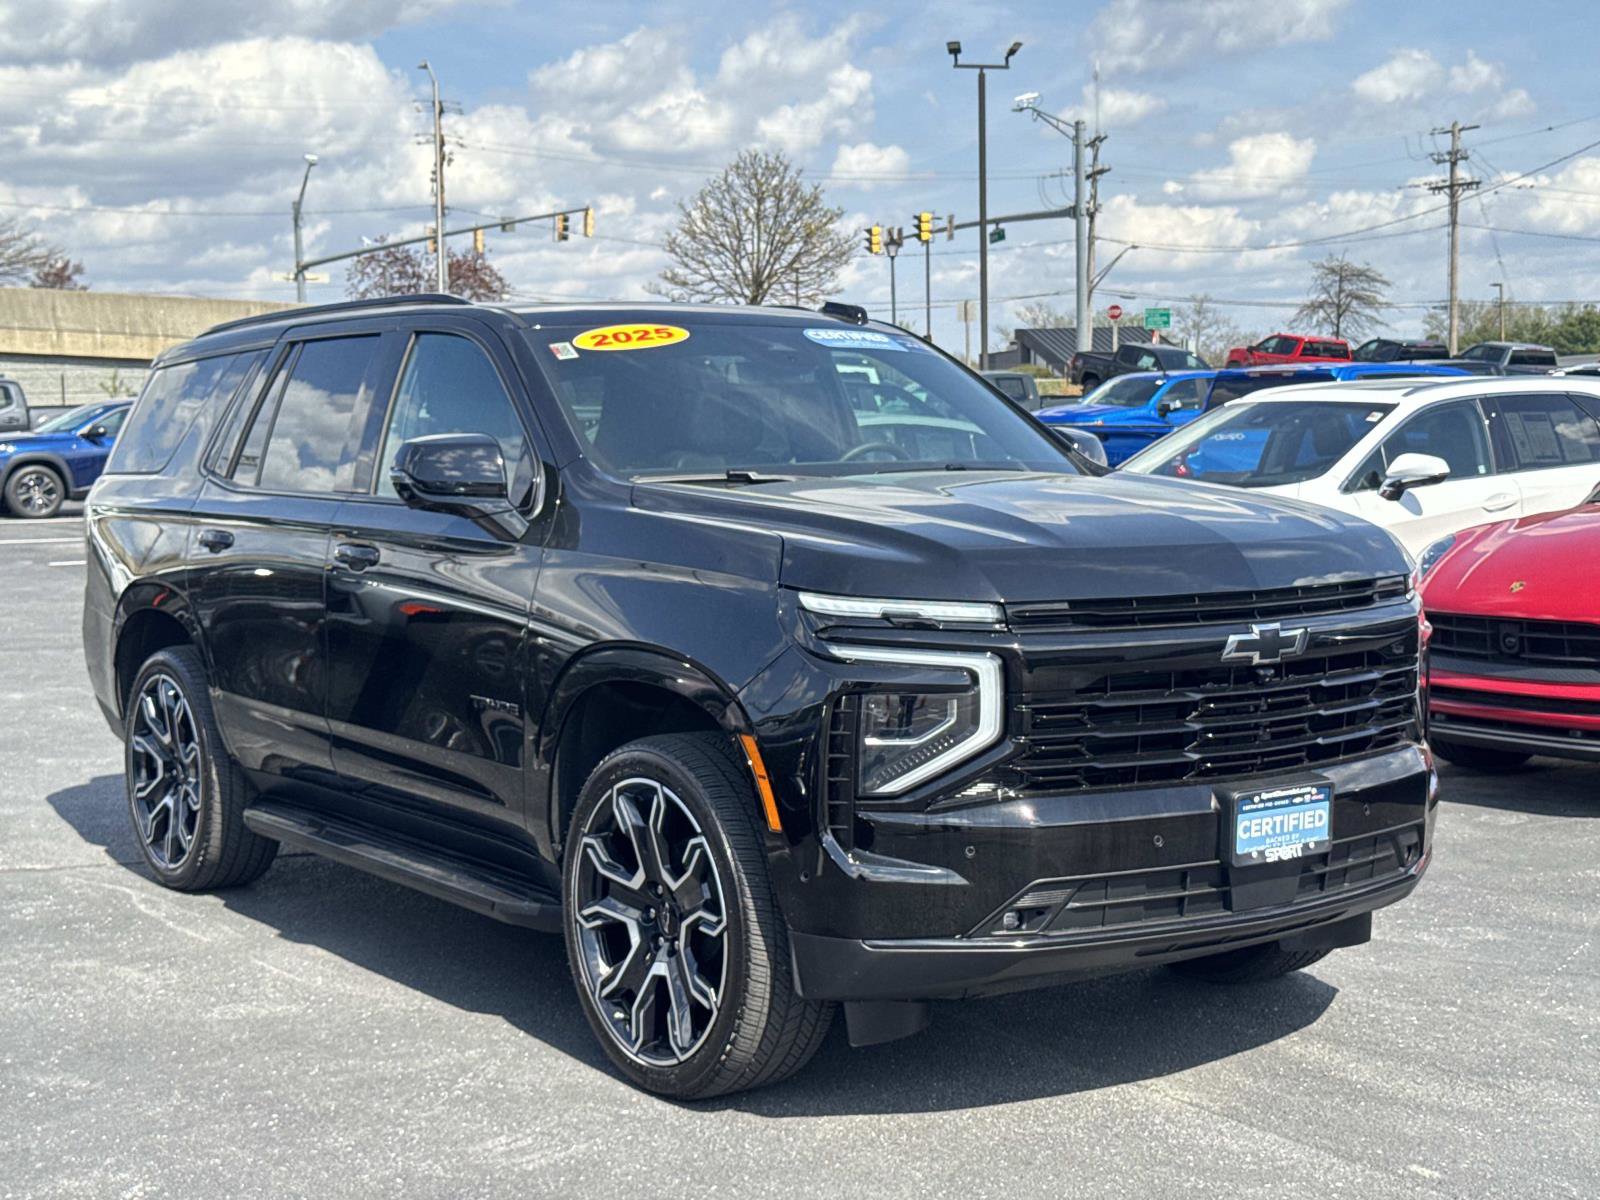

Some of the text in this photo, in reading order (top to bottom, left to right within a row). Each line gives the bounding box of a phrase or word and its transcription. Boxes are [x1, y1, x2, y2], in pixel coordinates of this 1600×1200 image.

[590, 327, 674, 347] 2025
[1239, 808, 1326, 840] CERTIFIED
[1264, 843, 1304, 862] SPORT
